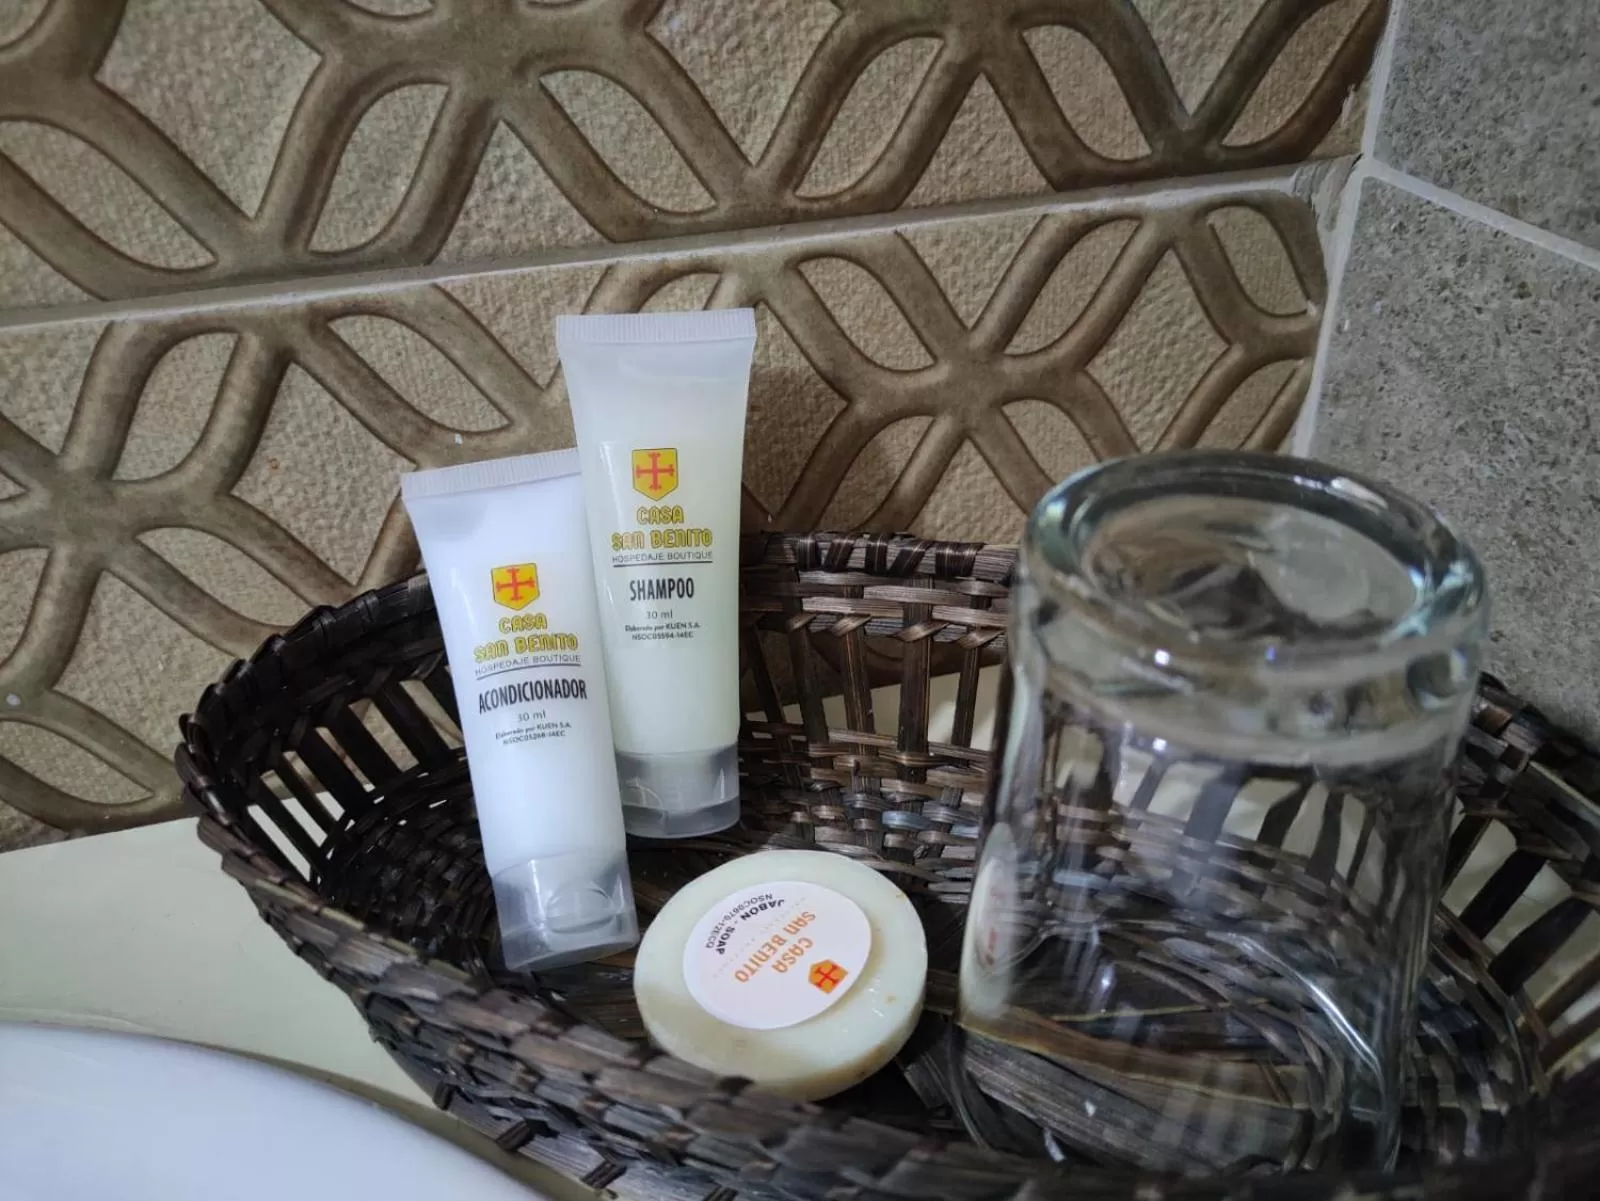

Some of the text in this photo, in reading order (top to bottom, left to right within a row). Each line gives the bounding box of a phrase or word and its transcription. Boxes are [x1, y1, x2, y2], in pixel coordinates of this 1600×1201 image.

[637, 505, 684, 525] CASA
[611, 528, 713, 551] SAN BENITO
[612, 551, 713, 563] HOSPEDAJE BOUTIQUE
[629, 577, 694, 601] SHAMPOO
[498, 613, 548, 634] CASA
[647, 609, 673, 619] 30 ml
[666, 622, 687, 630] KUEN
[474, 633, 579, 663] SAN BENITO
[475, 654, 581, 676] HOSPEDAJE BOUTIQUE
[479, 678, 588, 714] ACONDICIONADOR
[518, 709, 547, 723] 30 ml
[536, 722, 558, 731] KUEN
[783, 911, 816, 935] SAN
[715, 926, 736, 955] SOAP
[734, 934, 788, 983] BENITO
[771, 937, 813, 973] CASA
